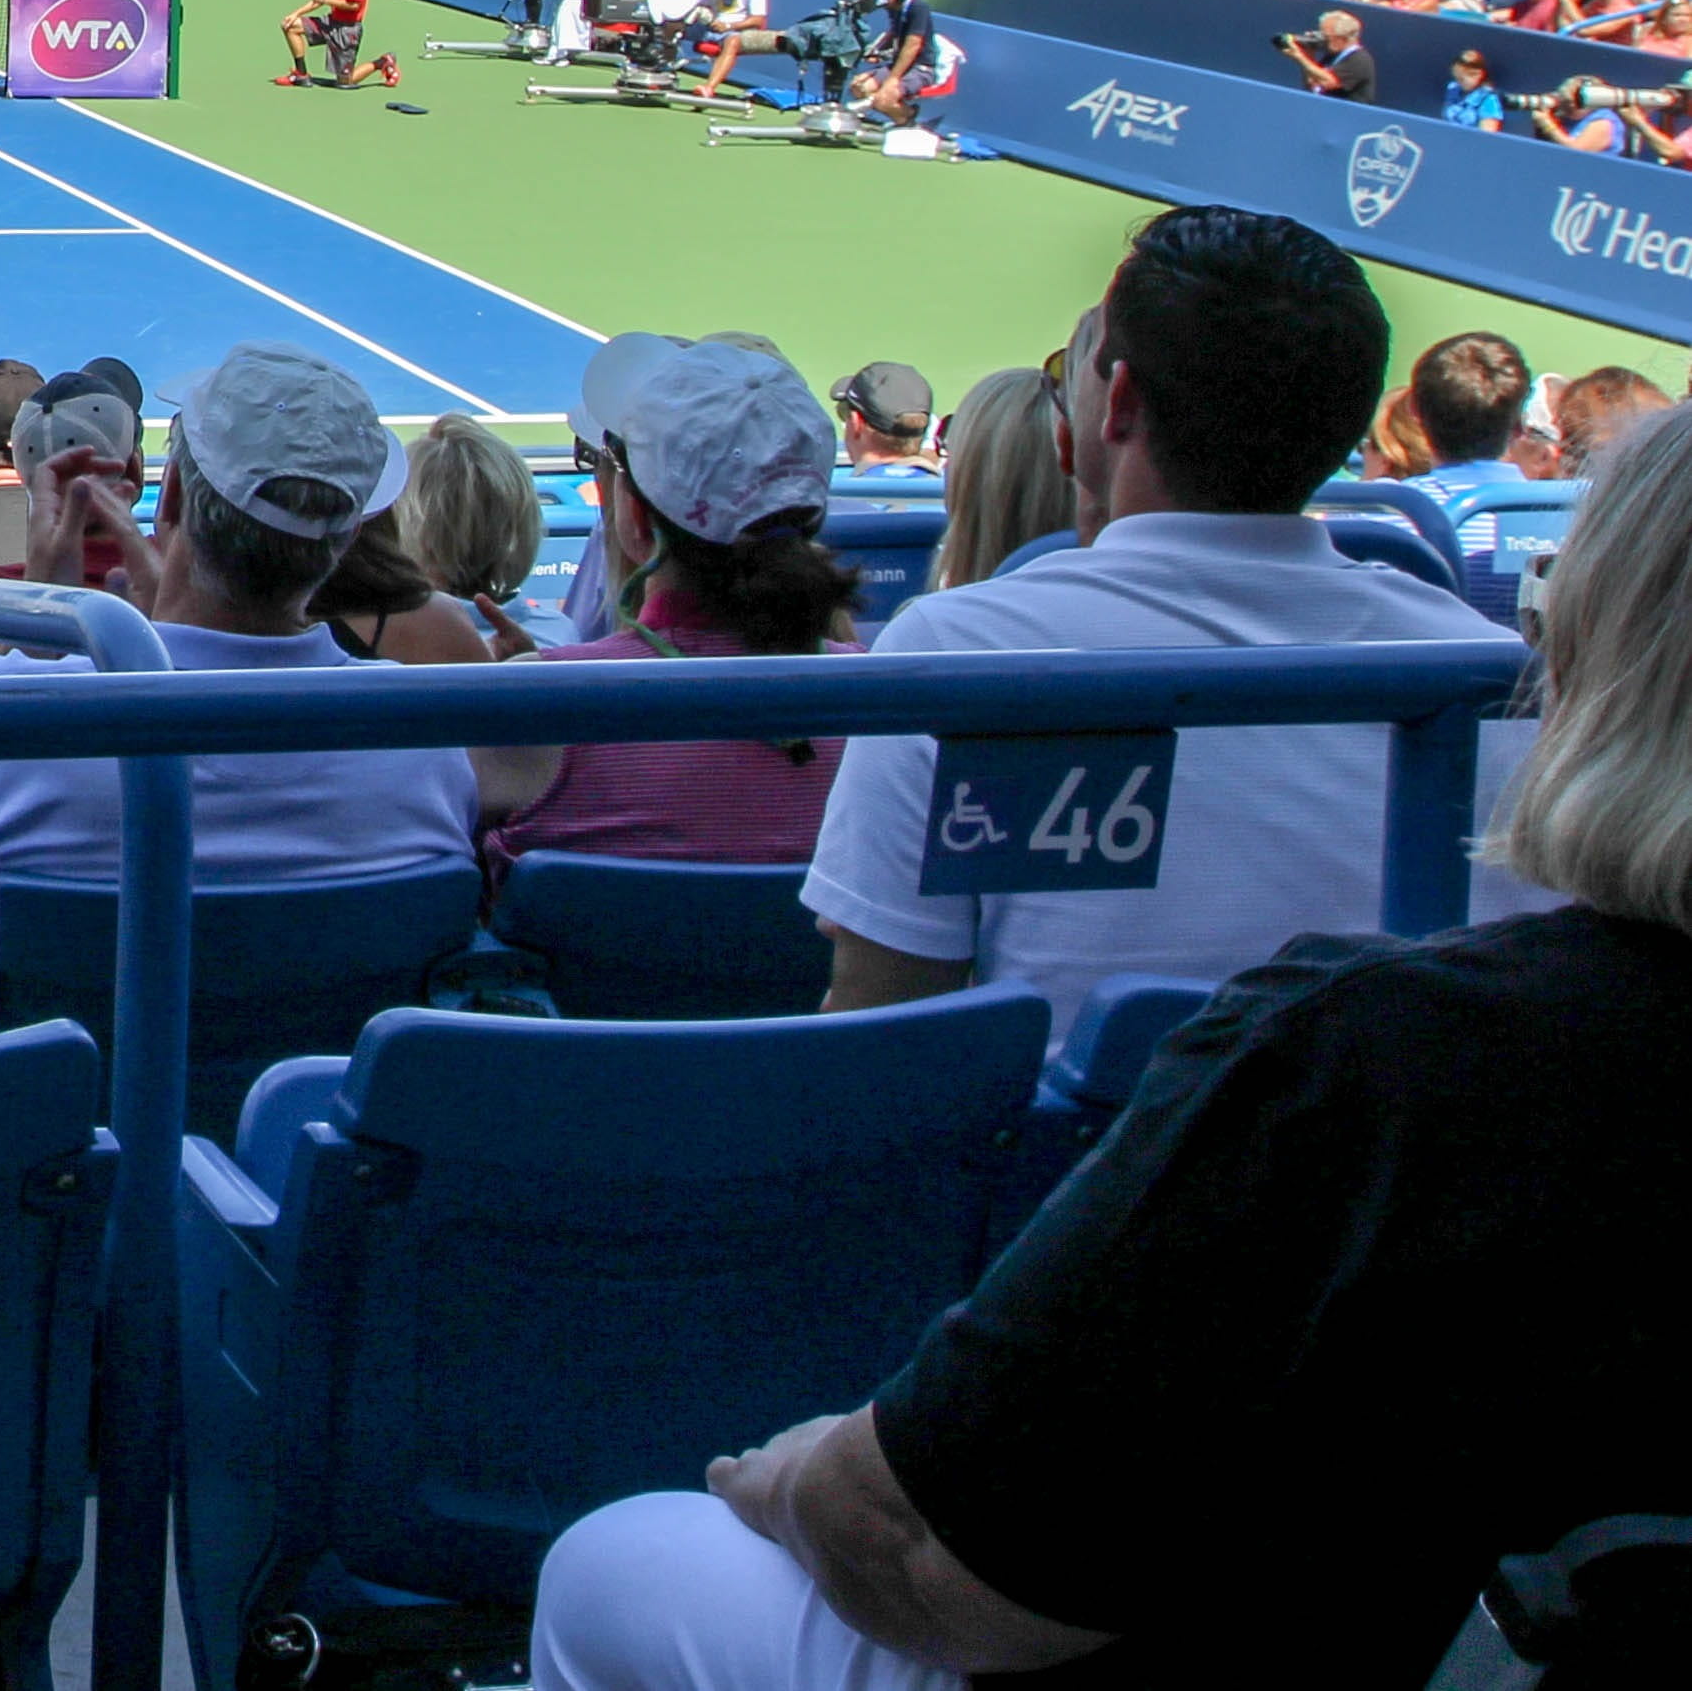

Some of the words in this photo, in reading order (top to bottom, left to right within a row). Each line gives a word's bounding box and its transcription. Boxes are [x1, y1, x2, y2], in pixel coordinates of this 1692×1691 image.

[41, 19, 136, 50] WTA
[1065, 77, 1190, 140] APEX
[1601, 206, 1692, 278] Hea
[1028, 764, 1155, 864] 46
